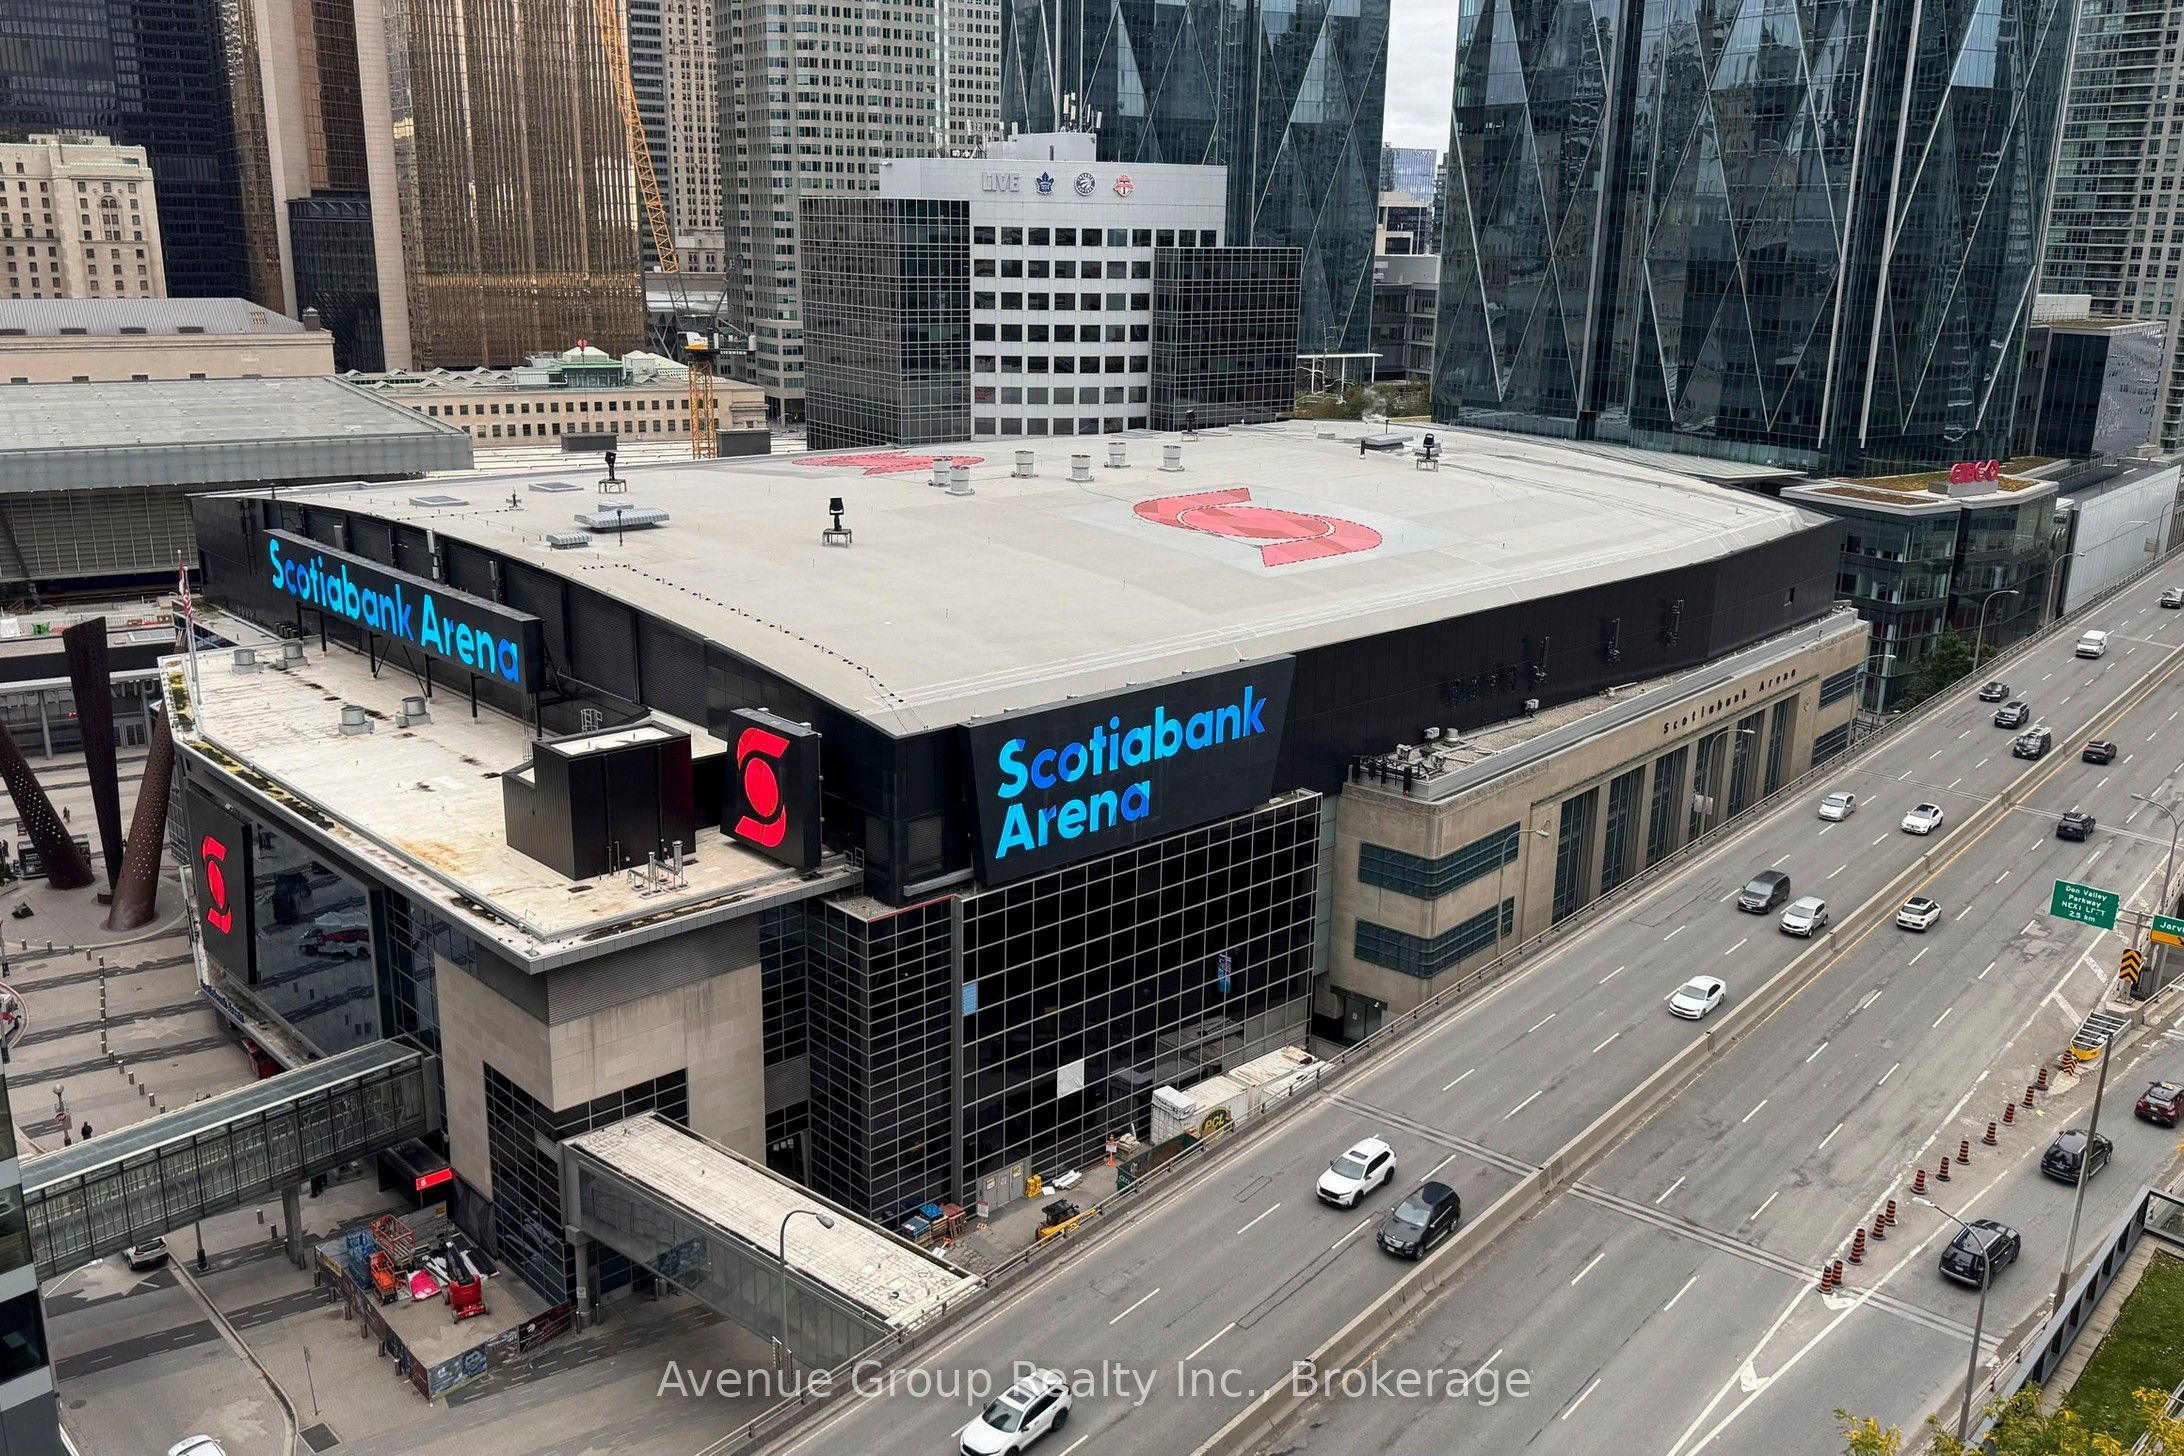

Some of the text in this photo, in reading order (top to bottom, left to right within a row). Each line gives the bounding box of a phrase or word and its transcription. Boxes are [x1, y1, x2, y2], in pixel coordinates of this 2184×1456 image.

[982, 172, 1019, 192] LIVE
[269, 539, 520, 683] Scotiabank Arena
[1663, 668, 1796, 734] Scotiabank Arena
[997, 685, 1267, 798] Scotiabank
[995, 780, 1150, 859] Arena
[2065, 885, 2107, 901] Don Valley
[2068, 894, 2101, 908] Parkway
[2083, 914, 2095, 922] km
